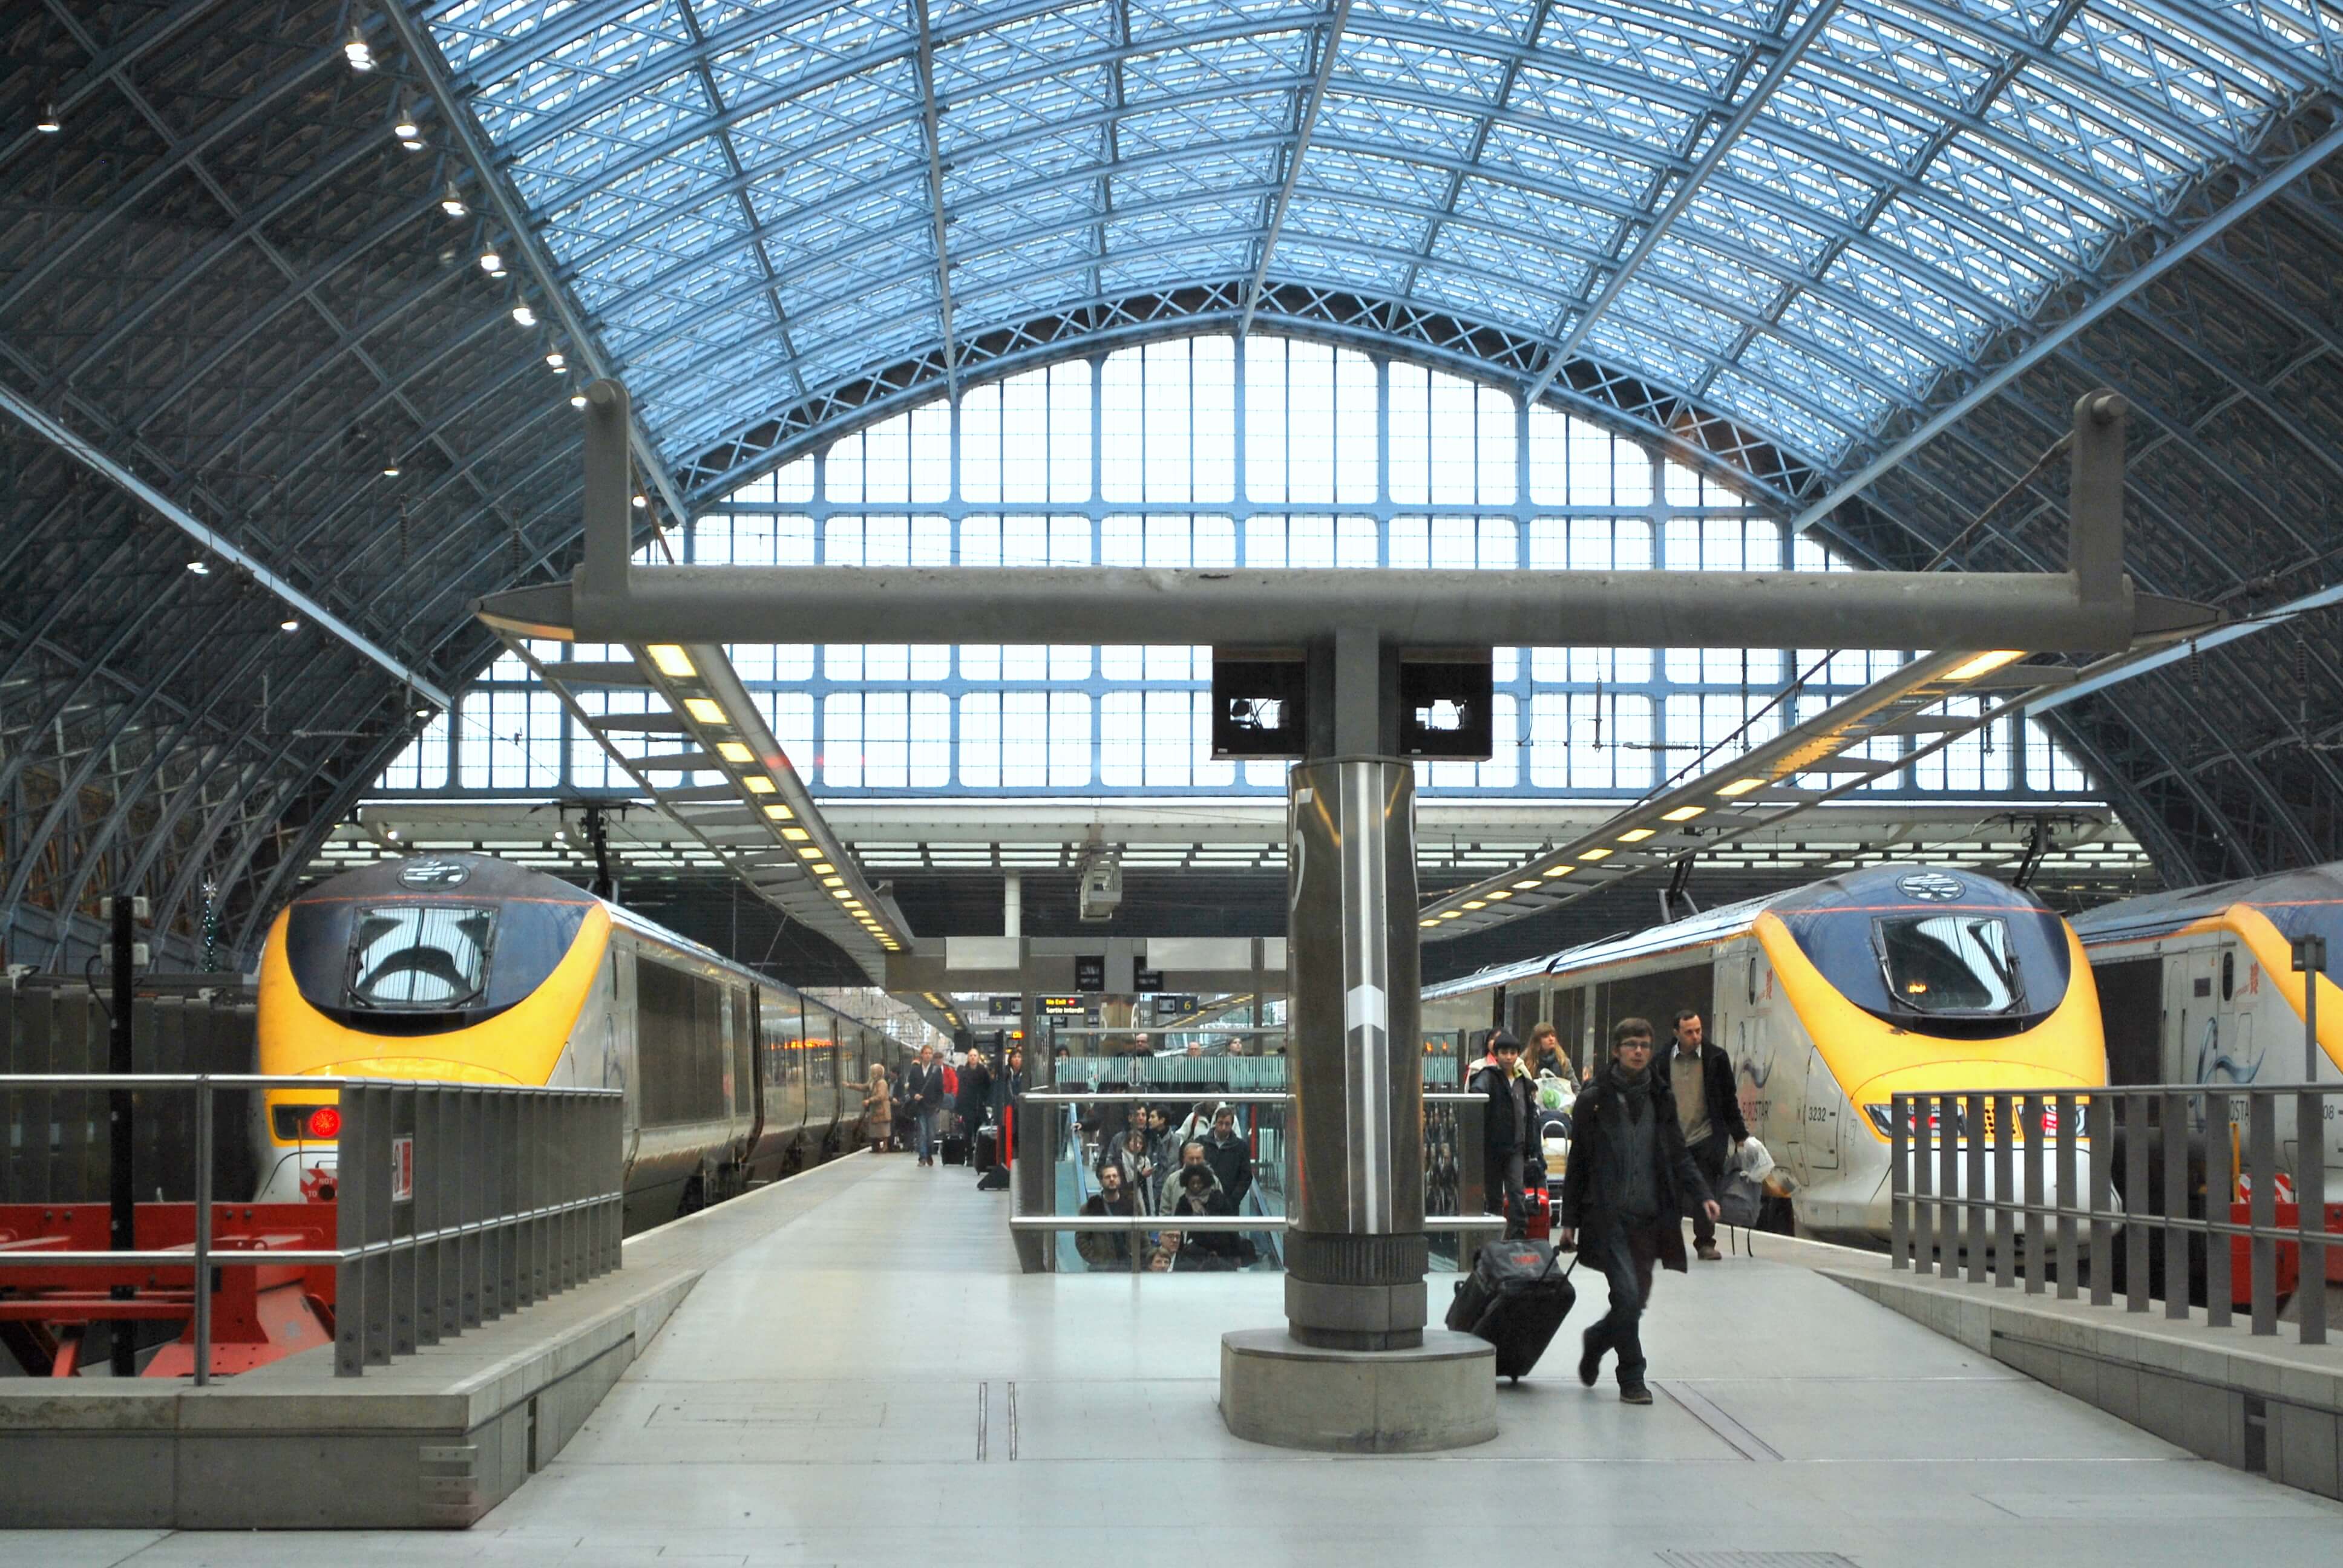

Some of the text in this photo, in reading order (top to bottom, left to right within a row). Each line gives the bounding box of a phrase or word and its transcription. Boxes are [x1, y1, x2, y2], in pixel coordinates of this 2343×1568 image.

[996, 1002, 1001, 1011] 5
[1184, 1001, 1191, 1010] 6
[1101, 1002, 1107, 1040] 5
[1131, 1002, 1139, 1039] 6
[1809, 1106, 1826, 1122] 3232
[2323, 1105, 2335, 1120] 08
